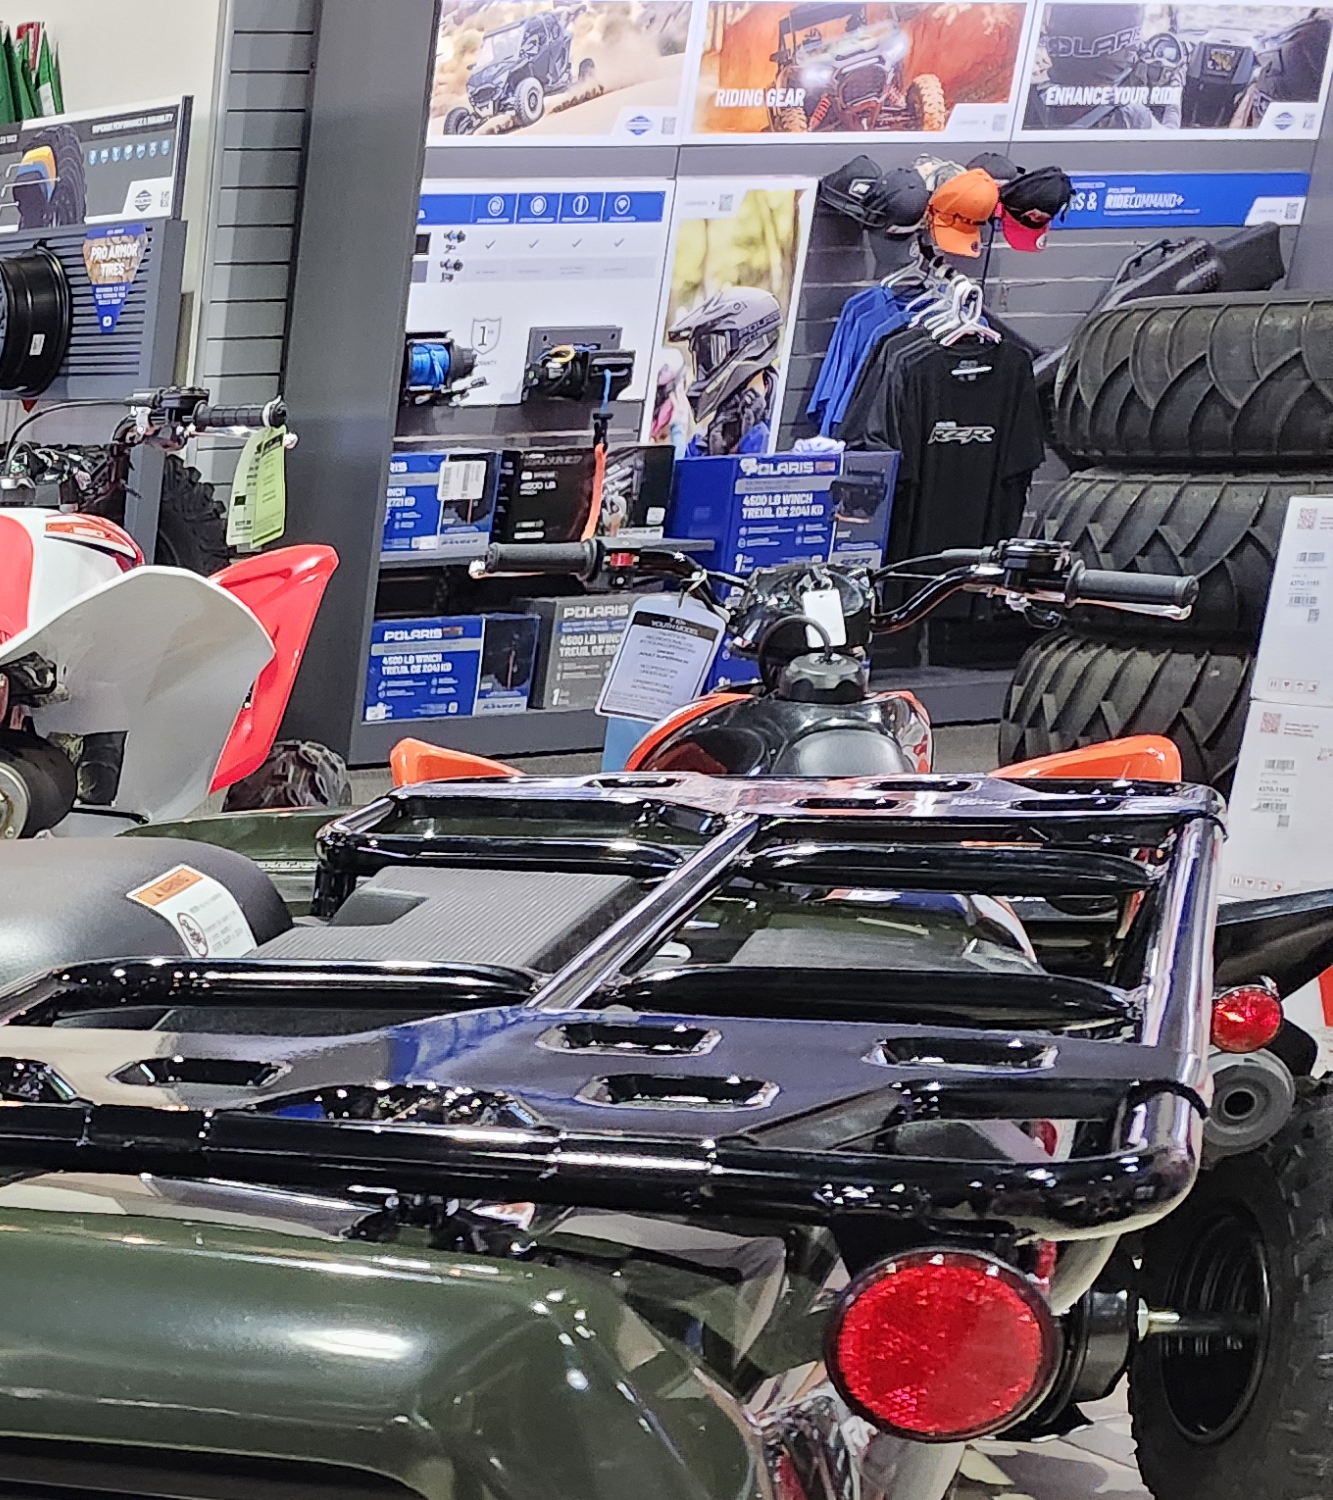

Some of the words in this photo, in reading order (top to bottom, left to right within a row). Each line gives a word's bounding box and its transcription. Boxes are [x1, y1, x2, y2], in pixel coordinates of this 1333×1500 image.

[714, 87, 764, 108] RIDING
[765, 87, 805, 108] GEAR
[1046, 86, 1109, 106] ENHANCE
[1111, 86, 1150, 105] YOUR
[1151, 86, 1181, 105] RIDE
[90, 246, 108, 260] PRO
[108, 242, 138, 259] ARMOR
[100, 263, 125, 277] TIRES
[743, 495, 767, 506] 4500
[768, 494, 782, 505] LB
[783, 493, 813, 505] WINCH
[742, 507, 774, 519] TREUIL
[776, 507, 788, 518] DE
[563, 604, 629, 618] POLARIS
[384, 629, 443, 641] POLARIS
[559, 633, 583, 645] 4500
[597, 632, 623, 644] WINC
